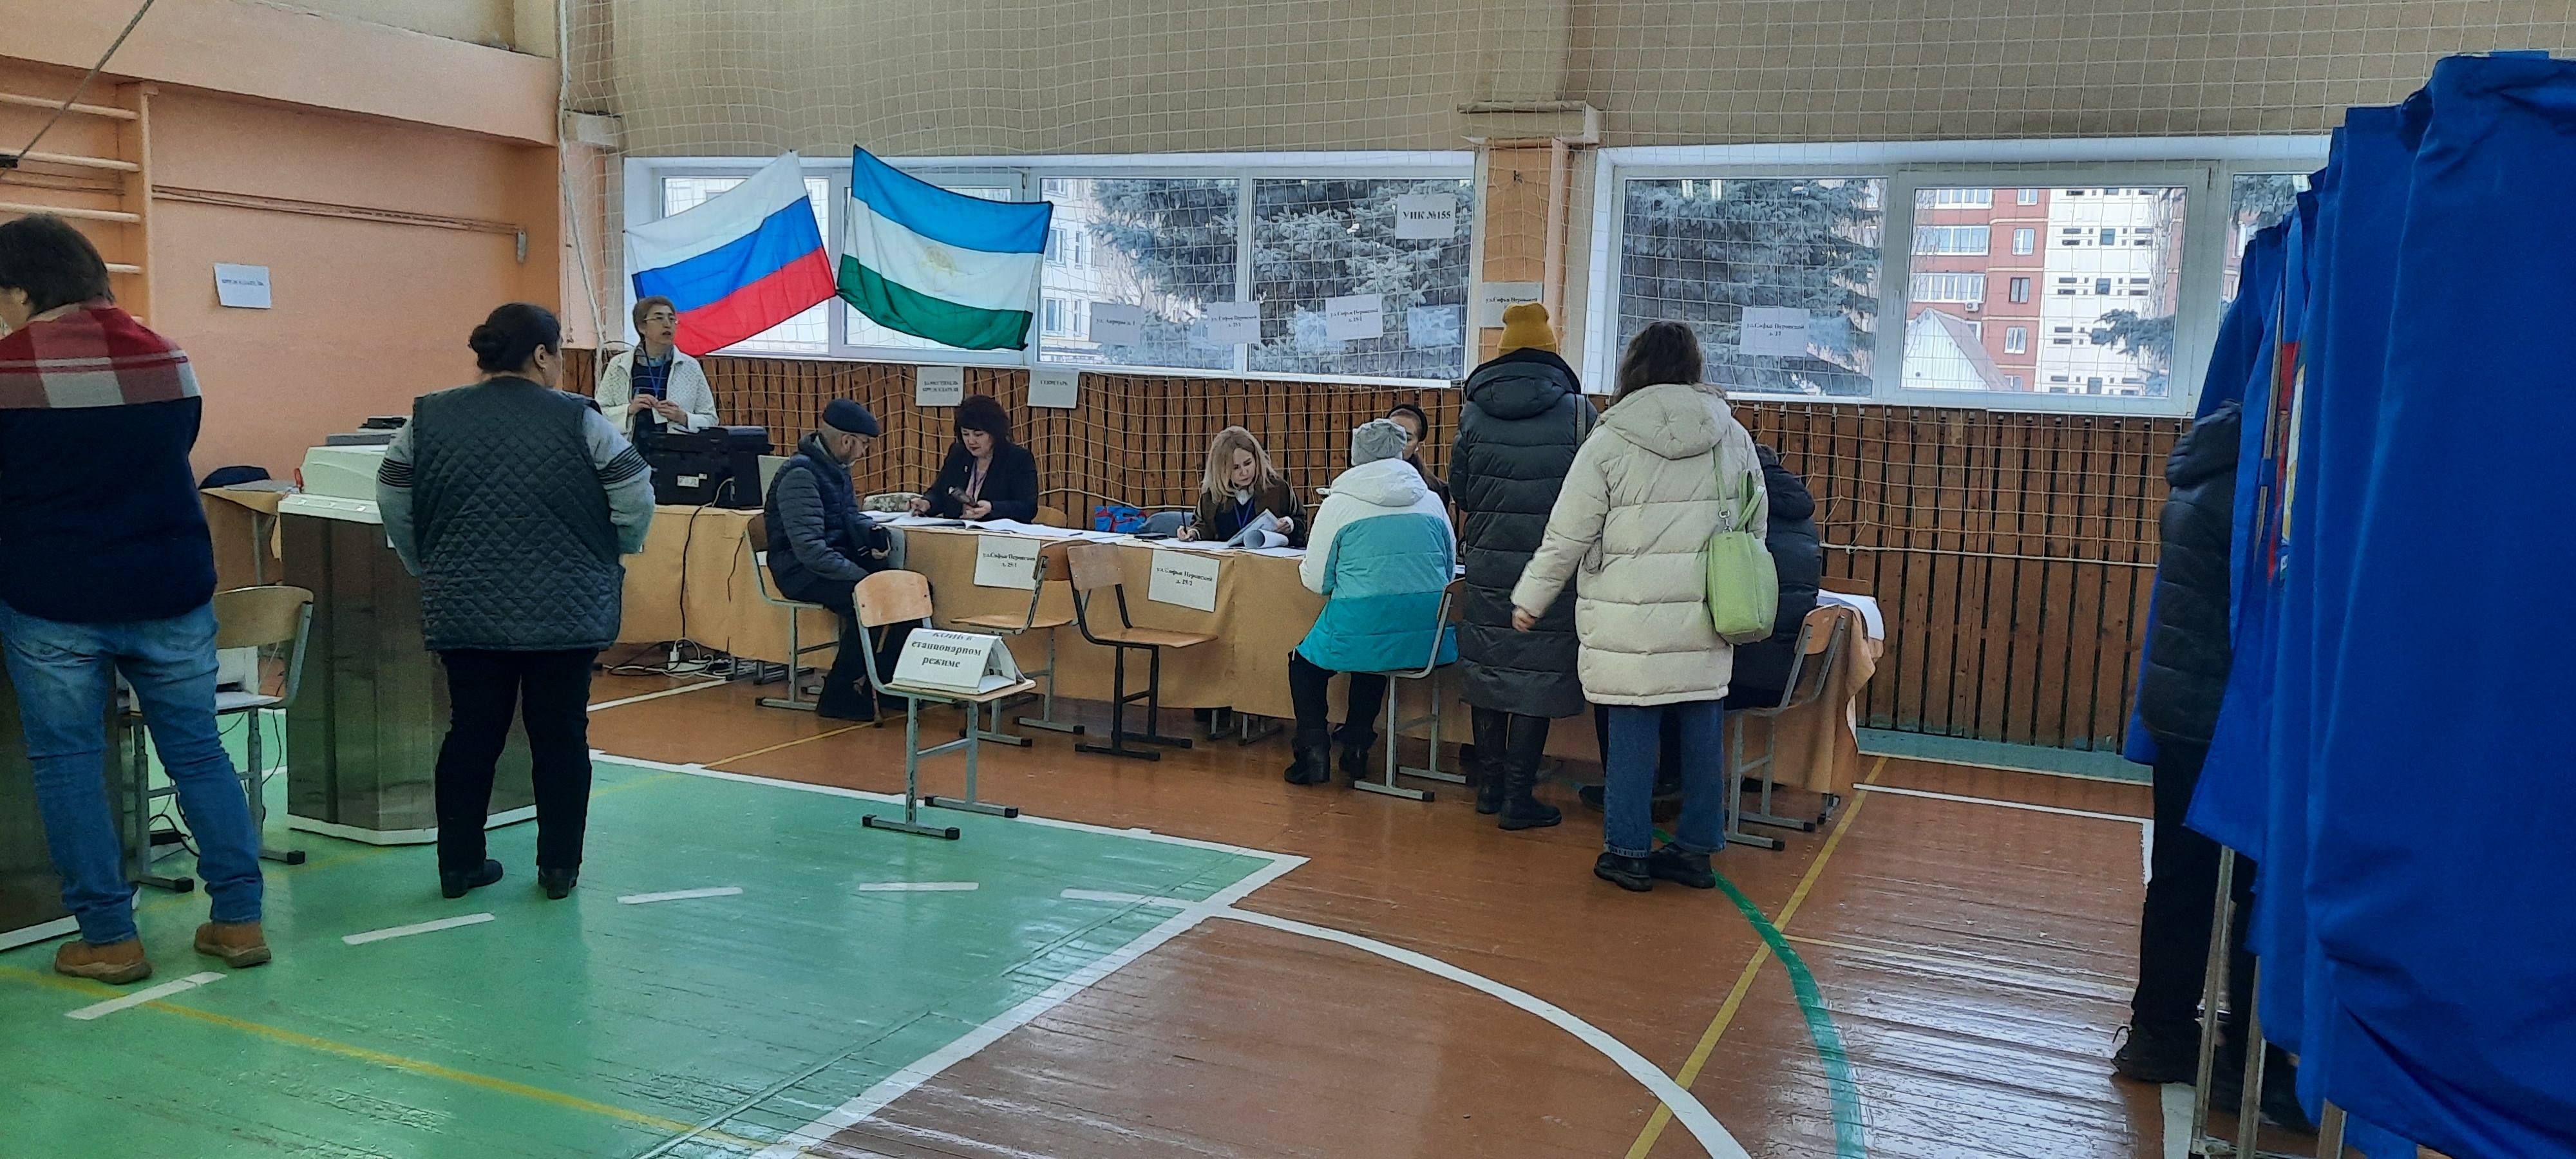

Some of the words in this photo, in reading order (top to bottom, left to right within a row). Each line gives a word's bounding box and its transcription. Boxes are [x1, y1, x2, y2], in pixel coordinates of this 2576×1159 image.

[1403, 211, 1425, 220] УИК
[1426, 211, 1451, 220] №155
[912, 641, 981, 655] стационарном
[922, 657, 960, 668] режиме
